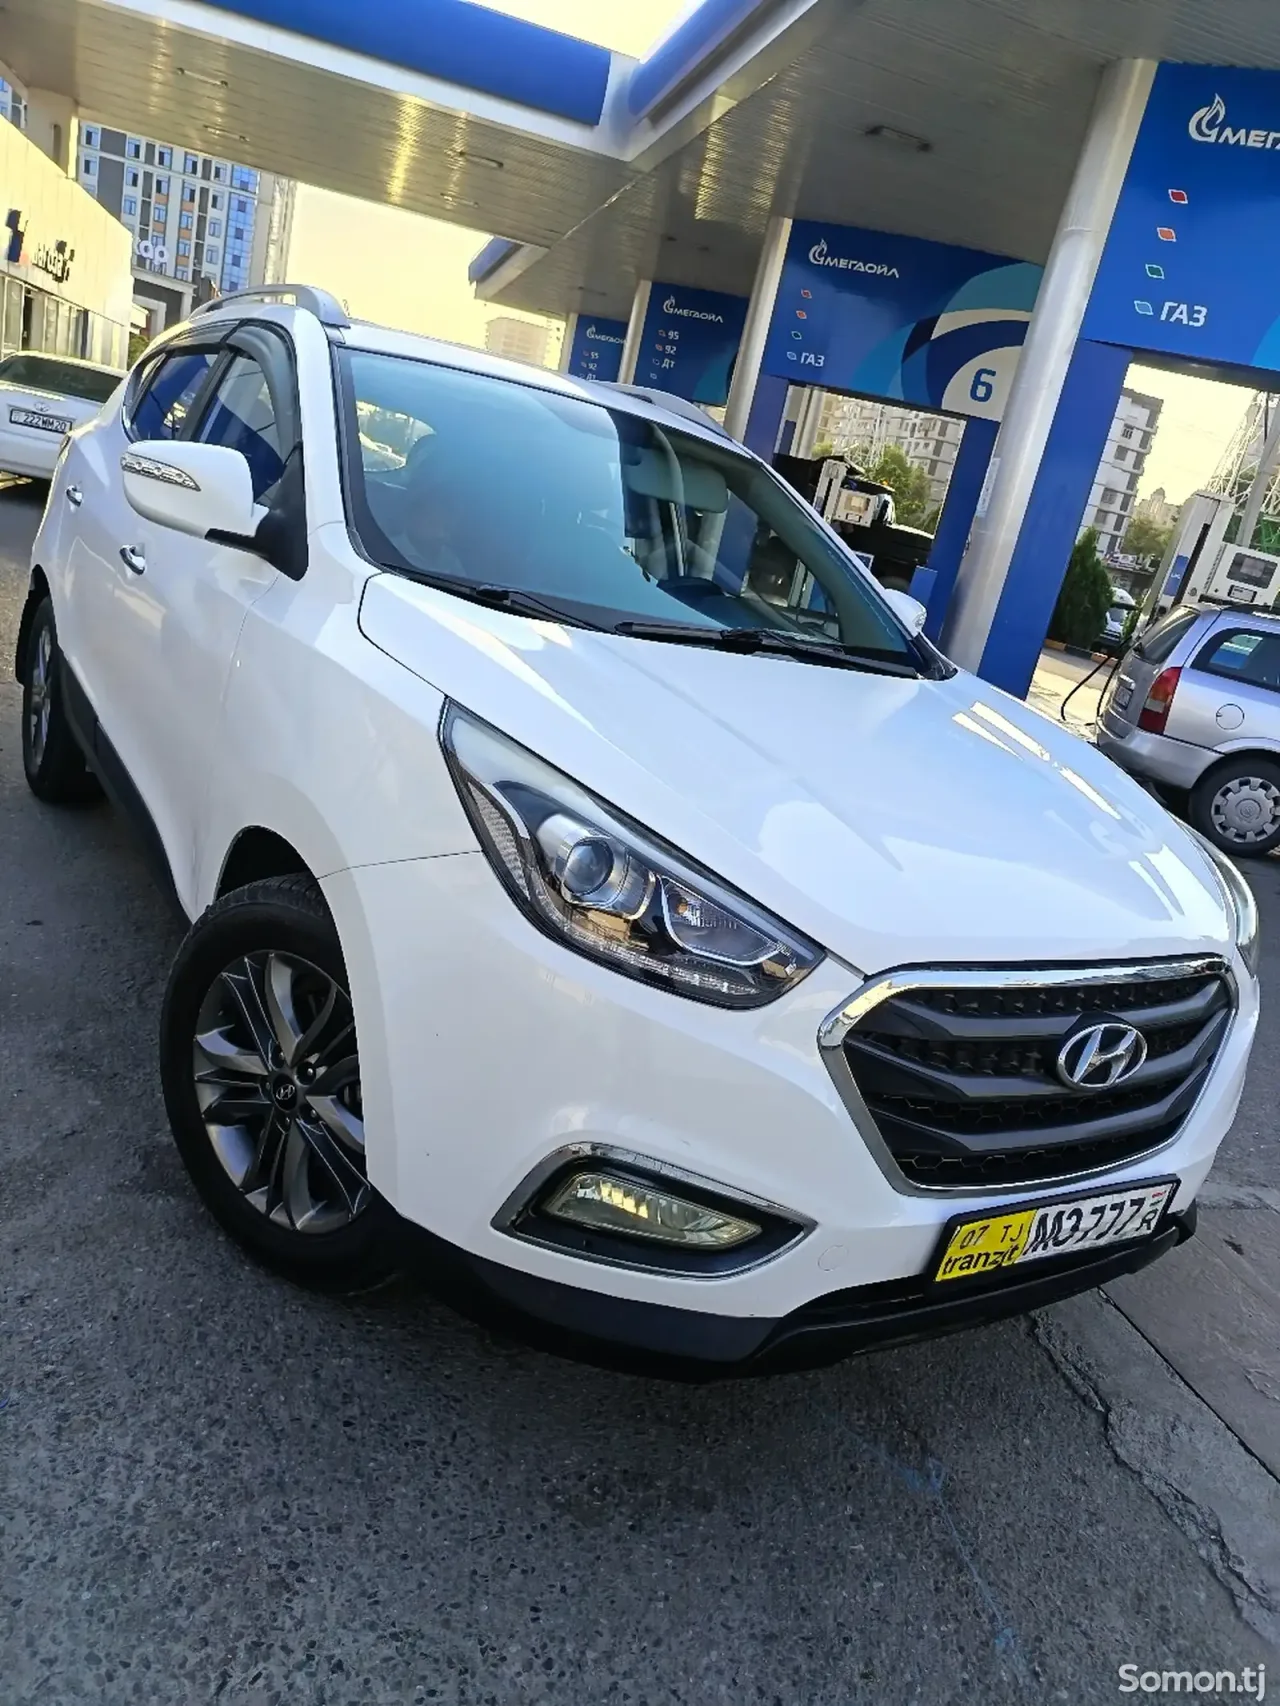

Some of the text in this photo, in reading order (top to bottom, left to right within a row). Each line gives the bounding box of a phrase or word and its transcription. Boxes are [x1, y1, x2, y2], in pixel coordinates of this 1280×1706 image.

[824, 256, 899, 278] МЕГАОЙЛ
[1160, 301, 1208, 327] ГАЗ
[668, 330, 679, 340] 95
[665, 345, 677, 355] 92
[800, 352, 825, 367] ГАЗ
[970, 368, 997, 403] 6
[960, 1223, 1024, 1250] 07 TJ
[942, 1243, 1019, 1275] tranzit
